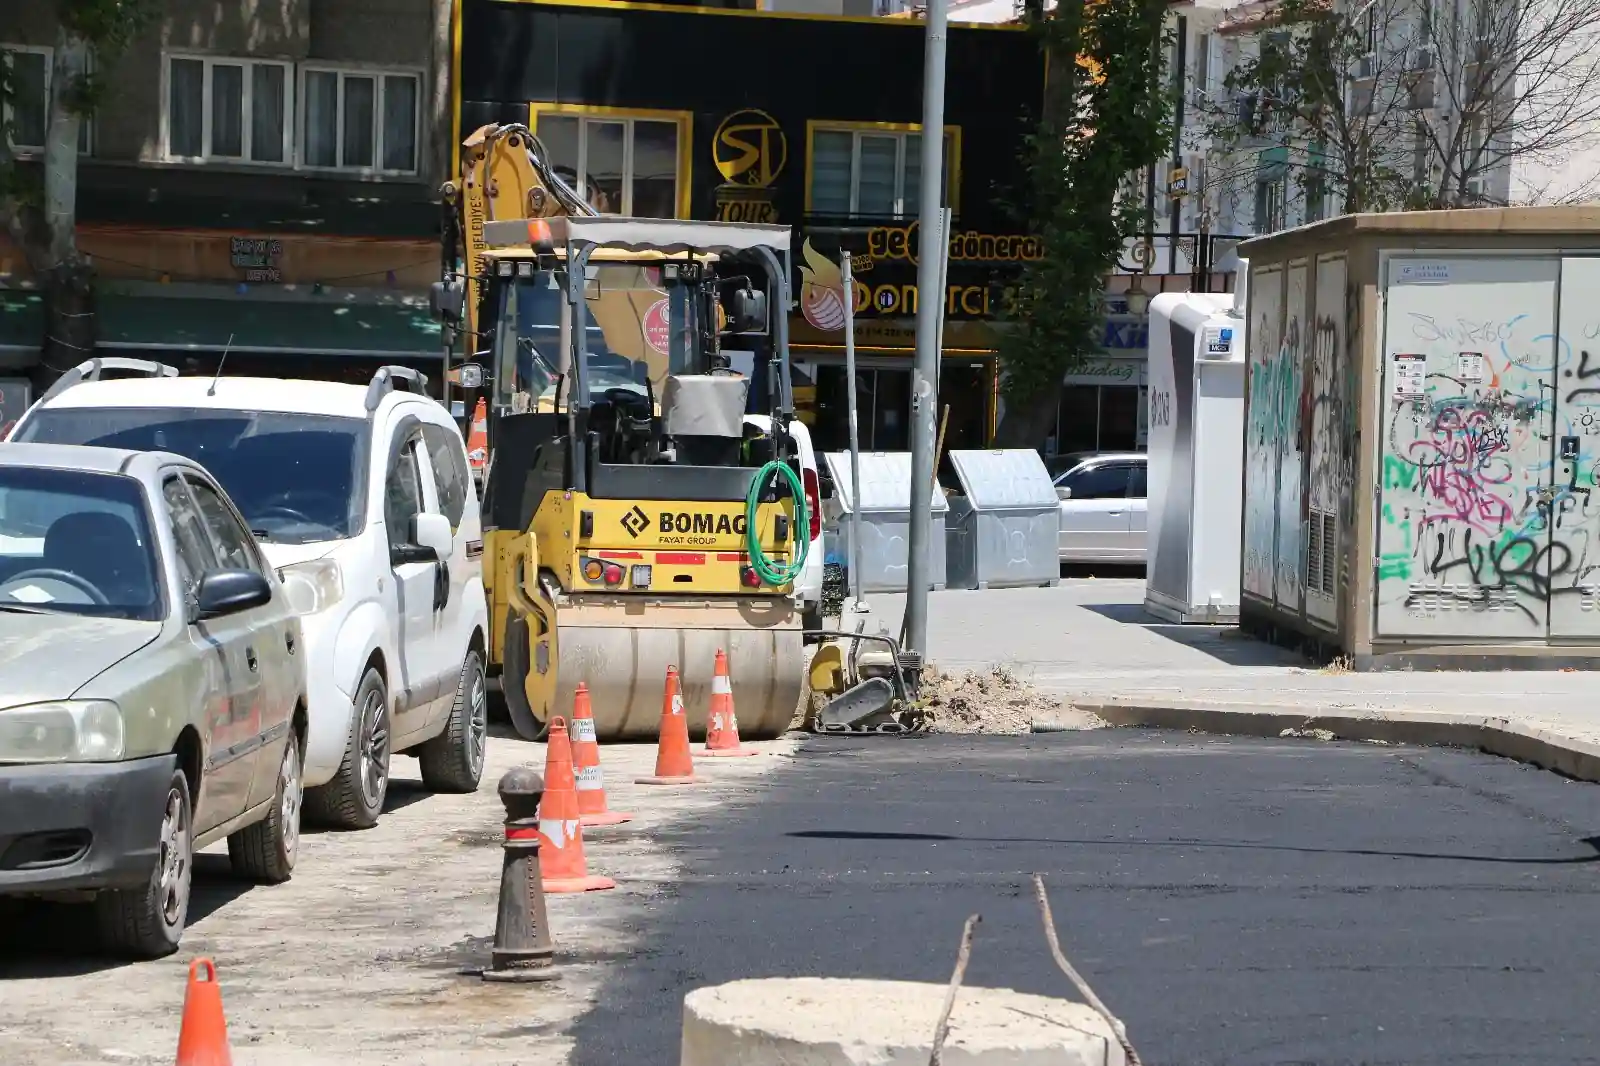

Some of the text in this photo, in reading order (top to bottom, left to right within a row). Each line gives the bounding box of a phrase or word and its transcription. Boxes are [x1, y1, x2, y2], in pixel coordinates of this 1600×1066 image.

[659, 512, 747, 535] BOMAG
[659, 536, 717, 545] FAYAT GROUP
